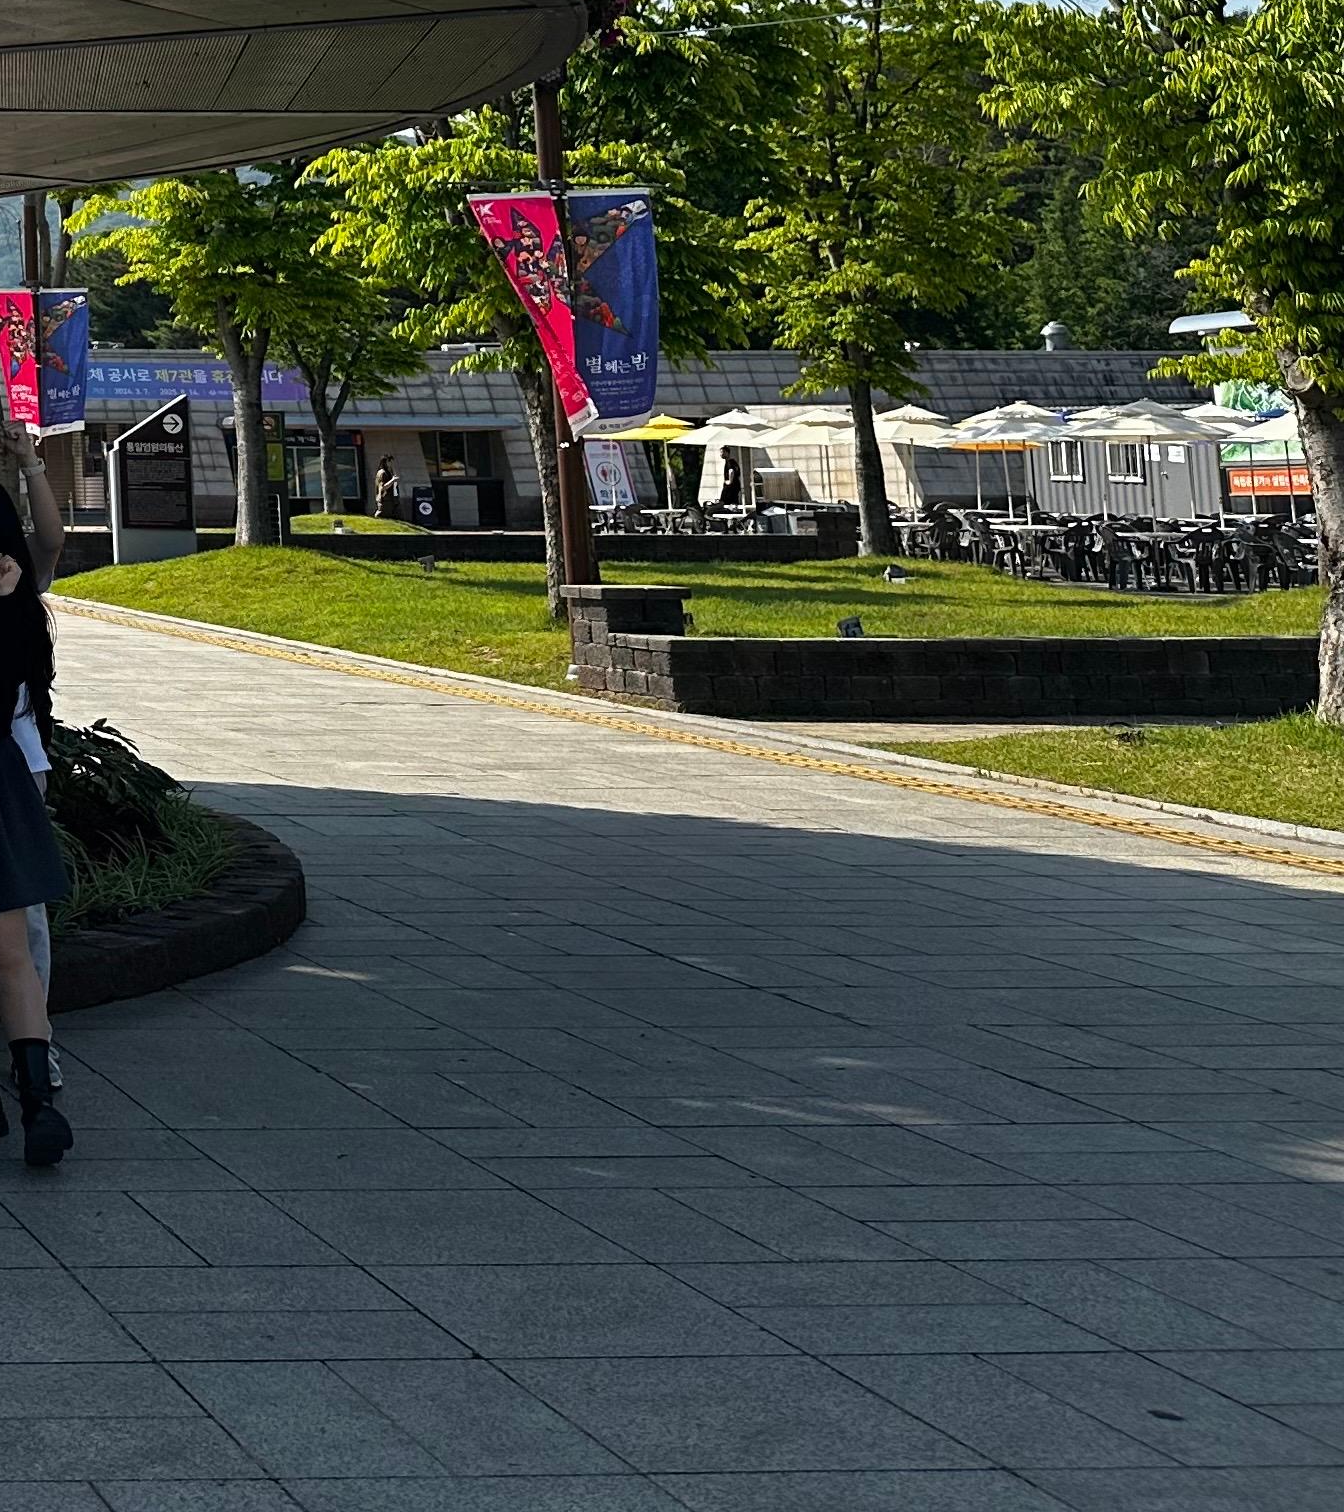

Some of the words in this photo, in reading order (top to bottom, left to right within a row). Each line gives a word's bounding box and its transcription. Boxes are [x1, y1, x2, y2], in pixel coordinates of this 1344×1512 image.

[585, 354, 602, 374] 별
[631, 352, 649, 371] 밤
[108, 367, 153, 383] 공사로
[154, 368, 208, 384] 제7관을
